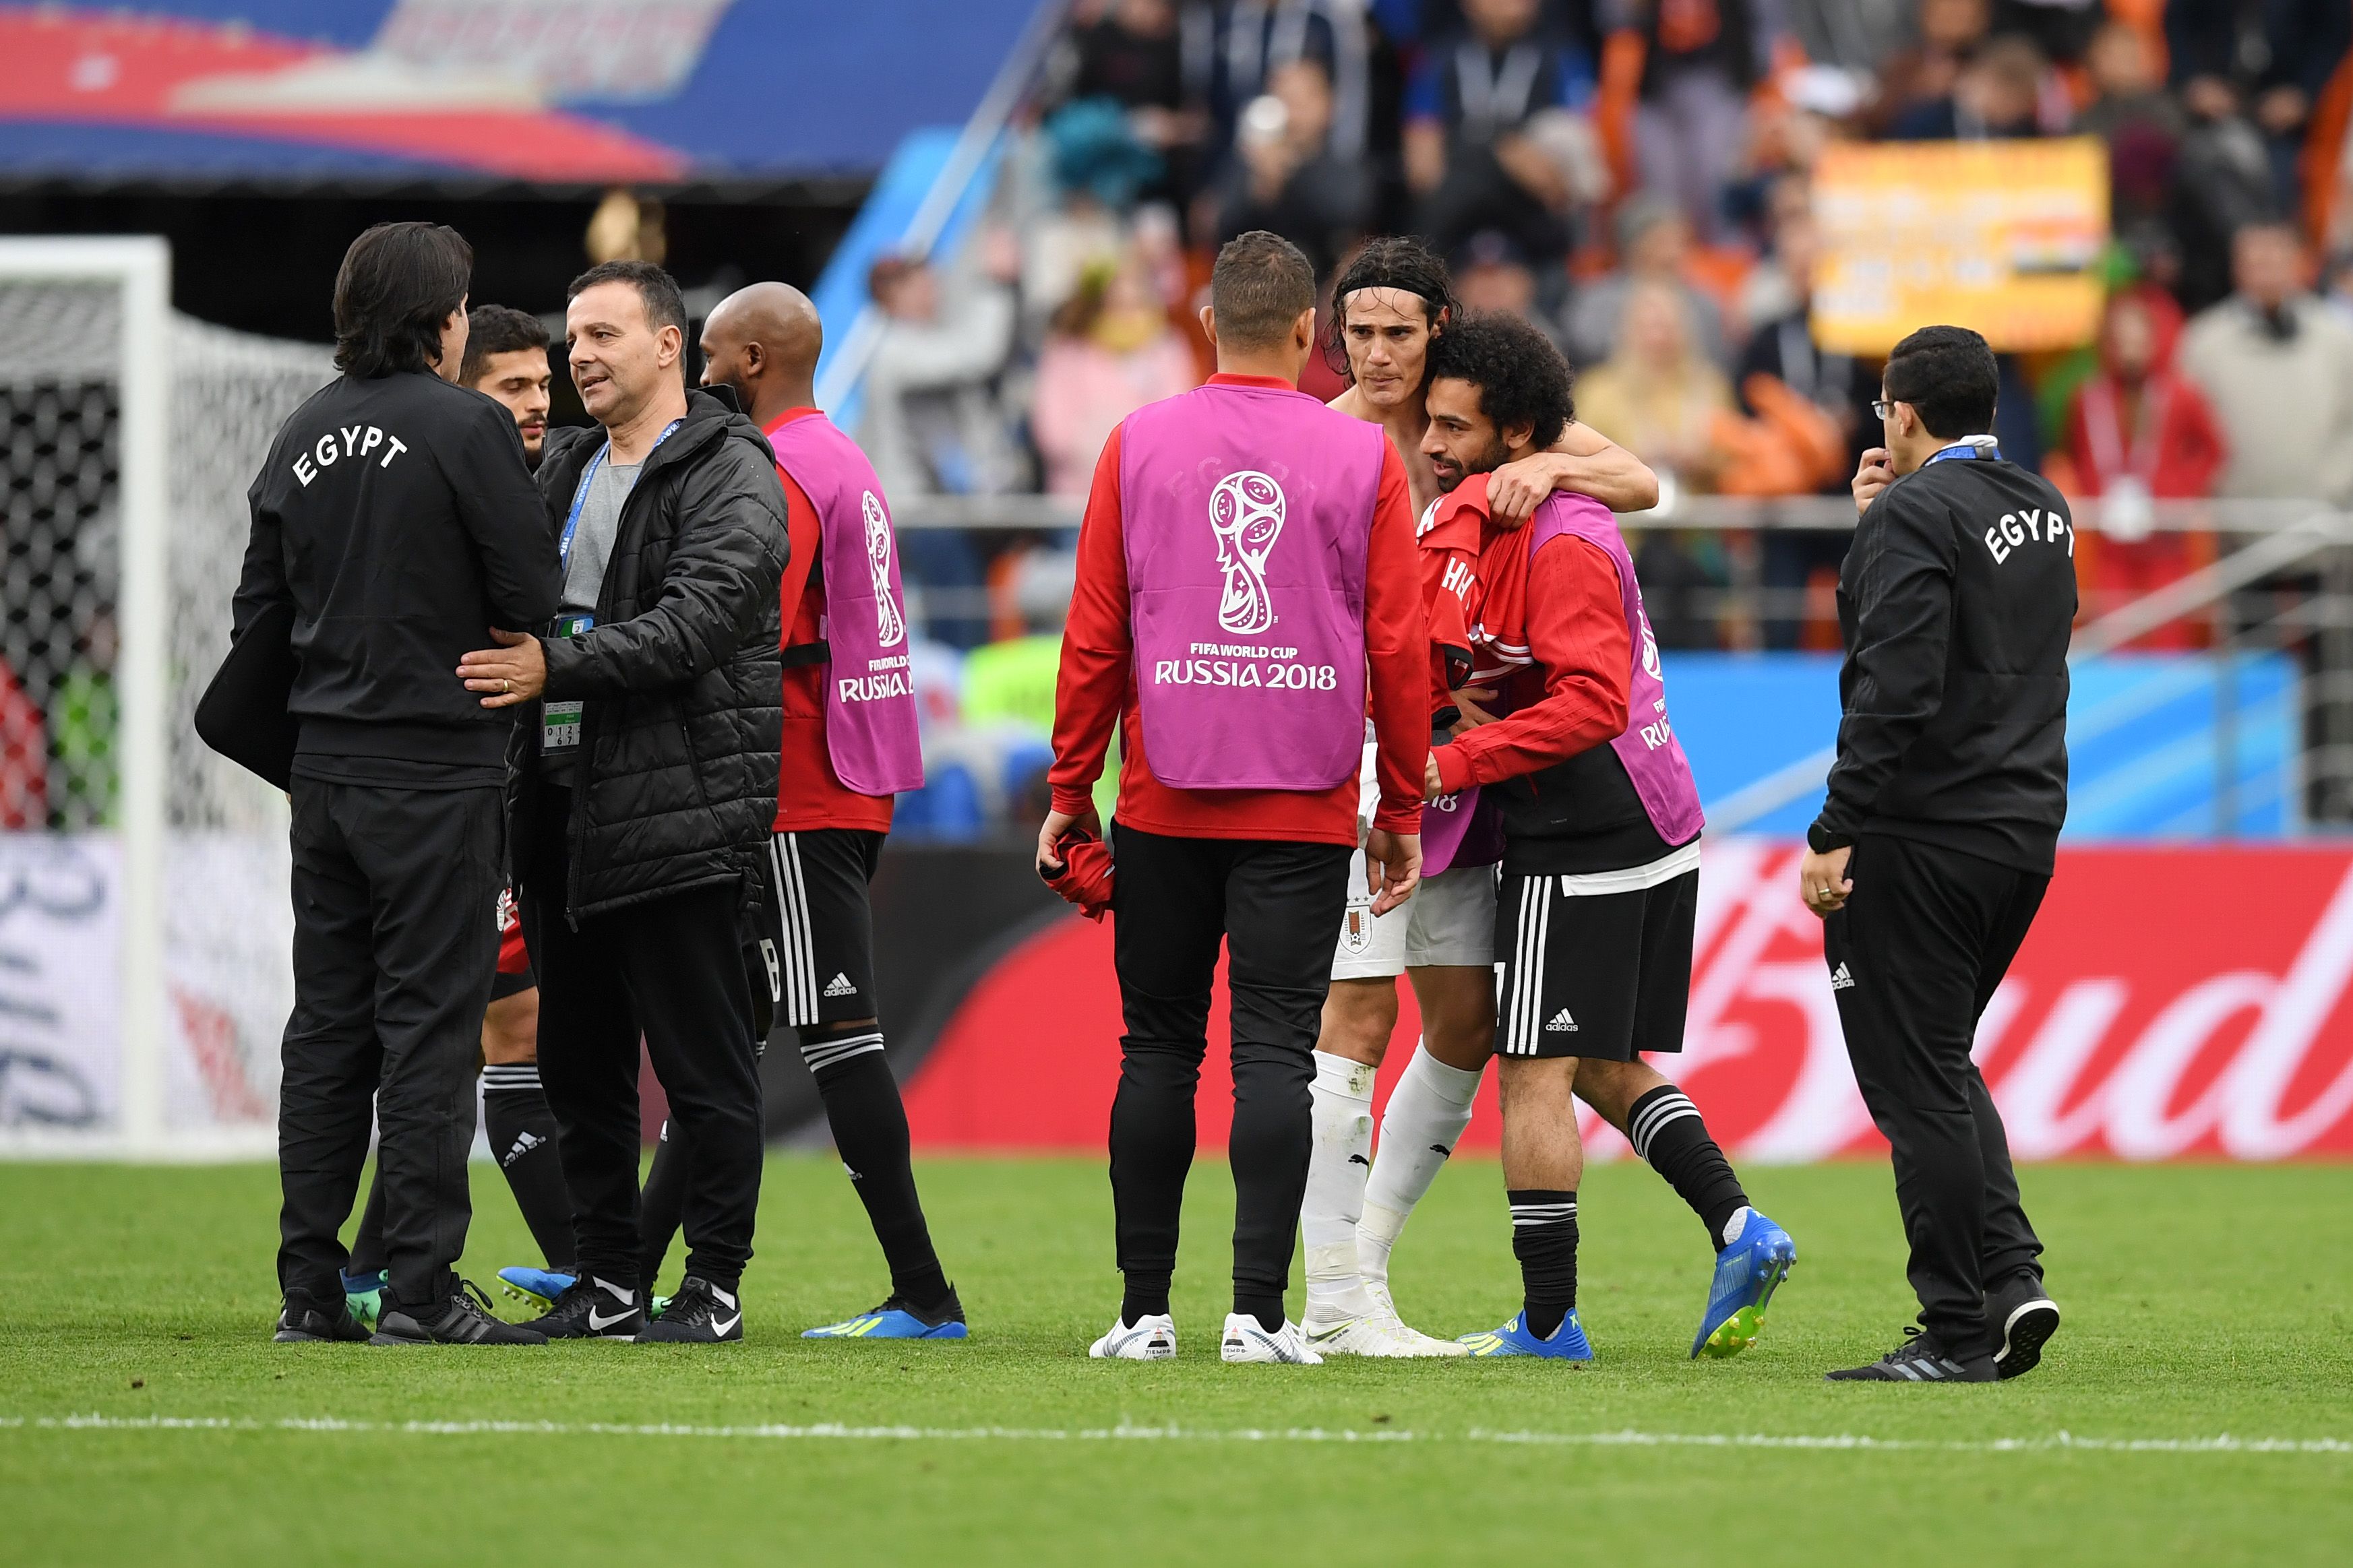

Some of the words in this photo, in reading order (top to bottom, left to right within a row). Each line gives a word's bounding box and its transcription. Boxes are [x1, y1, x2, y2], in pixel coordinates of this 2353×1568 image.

[292, 425, 408, 487] EGYPT
[1190, 643, 1219, 655] FIFA
[1220, 644, 1269, 658] WORLD
[1271, 647, 1297, 659] CUP
[1155, 660, 1262, 687] RUSSIA
[1265, 664, 1337, 691] 2018
[547, 727, 553, 736] 0
[568, 726, 573, 734] 2
[557, 736, 562, 745] 6
[567, 736, 572, 745] 7
[824, 986, 857, 997] adidas
[1546, 1022, 1579, 1032] adidas
